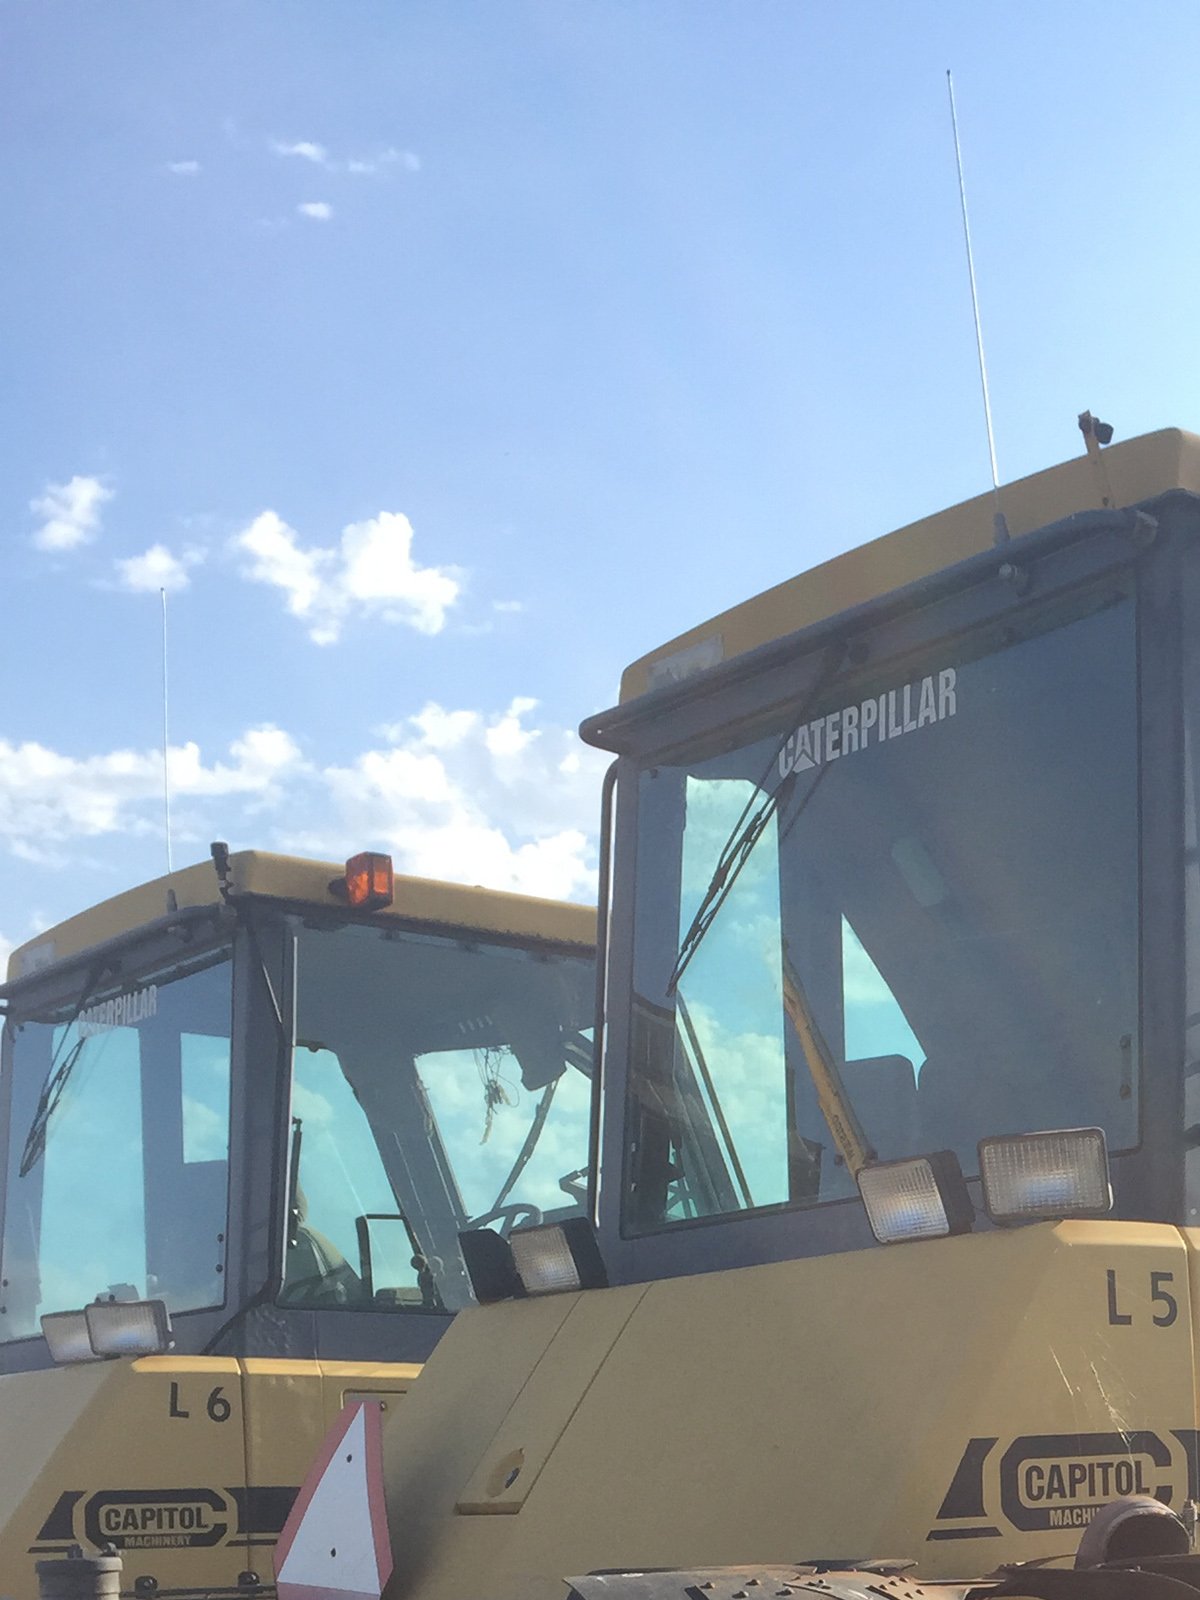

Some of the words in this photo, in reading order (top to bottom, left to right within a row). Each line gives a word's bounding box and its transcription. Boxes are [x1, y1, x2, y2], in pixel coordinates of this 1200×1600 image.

[779, 668, 956, 779] CATERPILLAR
[78, 985, 157, 1040] CATERPILLAR
[1107, 1269, 1132, 1325] L
[1151, 1272, 1177, 1327] 5
[170, 1382, 189, 1418] L
[207, 1387, 231, 1422] 6
[1025, 1460, 1150, 1501] CAPITOL
[105, 1507, 209, 1531] CAPITOL
[1049, 1506, 1099, 1527] MACHI
[124, 1535, 191, 1548] MACHINERY
